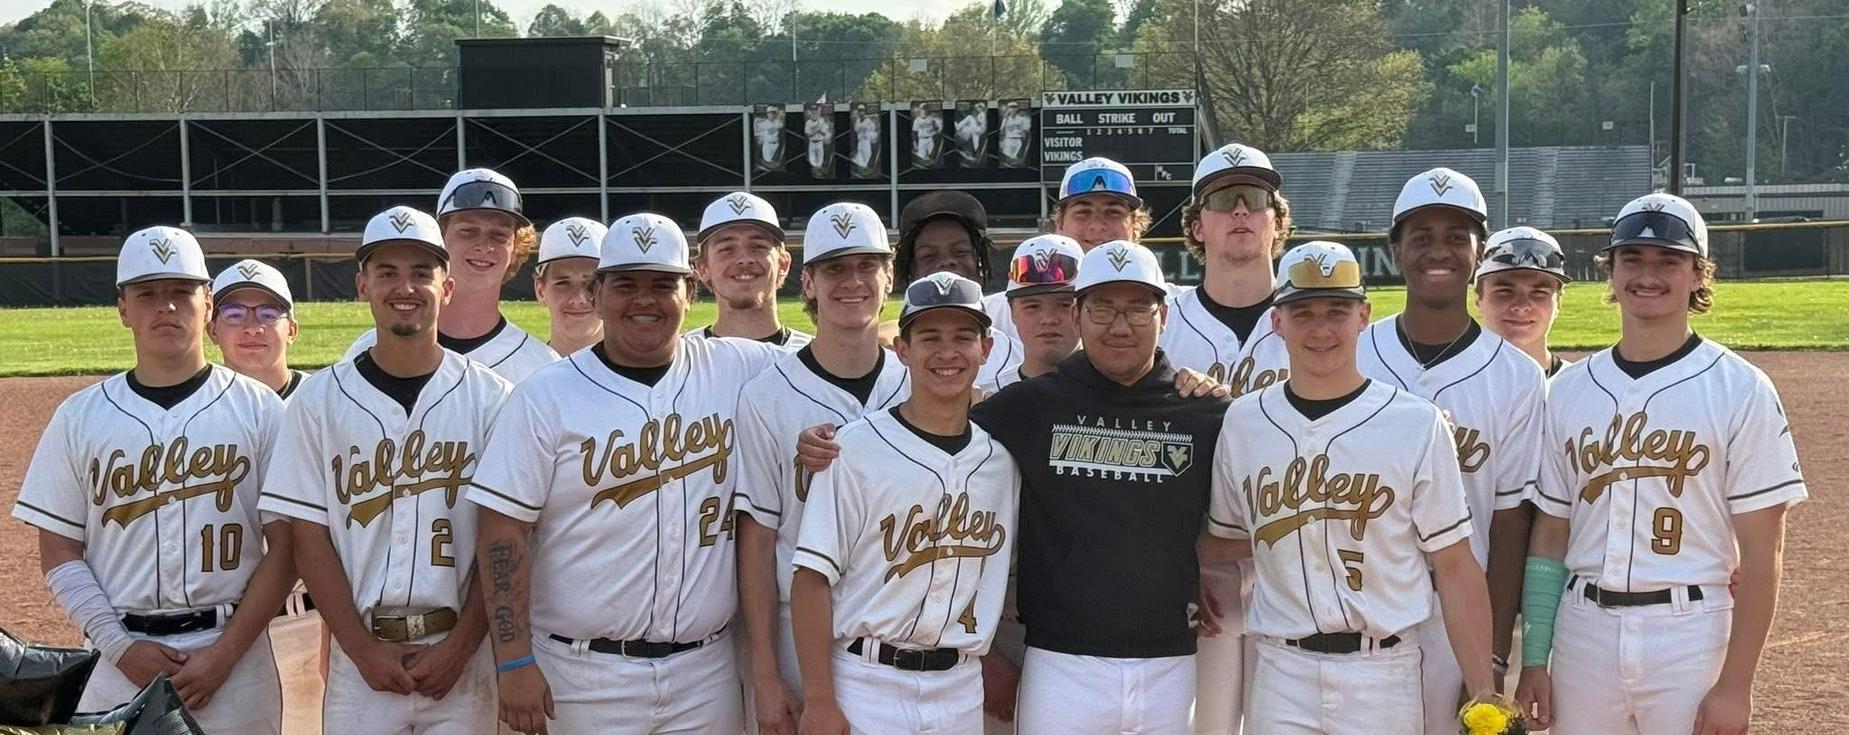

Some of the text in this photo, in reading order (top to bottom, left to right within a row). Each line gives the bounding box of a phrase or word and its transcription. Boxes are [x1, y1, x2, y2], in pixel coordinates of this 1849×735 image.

[1056, 112, 1176, 124] BALL STRIKE OUT
[1058, 92, 1180, 105] VALLEY VIKINGS
[1044, 137, 1083, 148] VISITOR
[1044, 151, 1084, 162] VIKINGS
[1077, 415, 1171, 432] VALLEY
[580, 412, 734, 509] Valley
[1049, 433, 1161, 468] VIKINGS
[1565, 411, 1710, 505] Valley
[89, 436, 251, 530] Valley
[332, 430, 476, 530] Valley
[1056, 466, 1163, 484] BASEBALL
[1243, 454, 1395, 551] Valley
[201, 523, 243, 573] 10
[431, 518, 456, 568] 2
[880, 491, 1006, 585] Valley
[1651, 507, 1683, 556] 9
[1337, 549, 1364, 592] 5
[957, 590, 978, 634] 4
